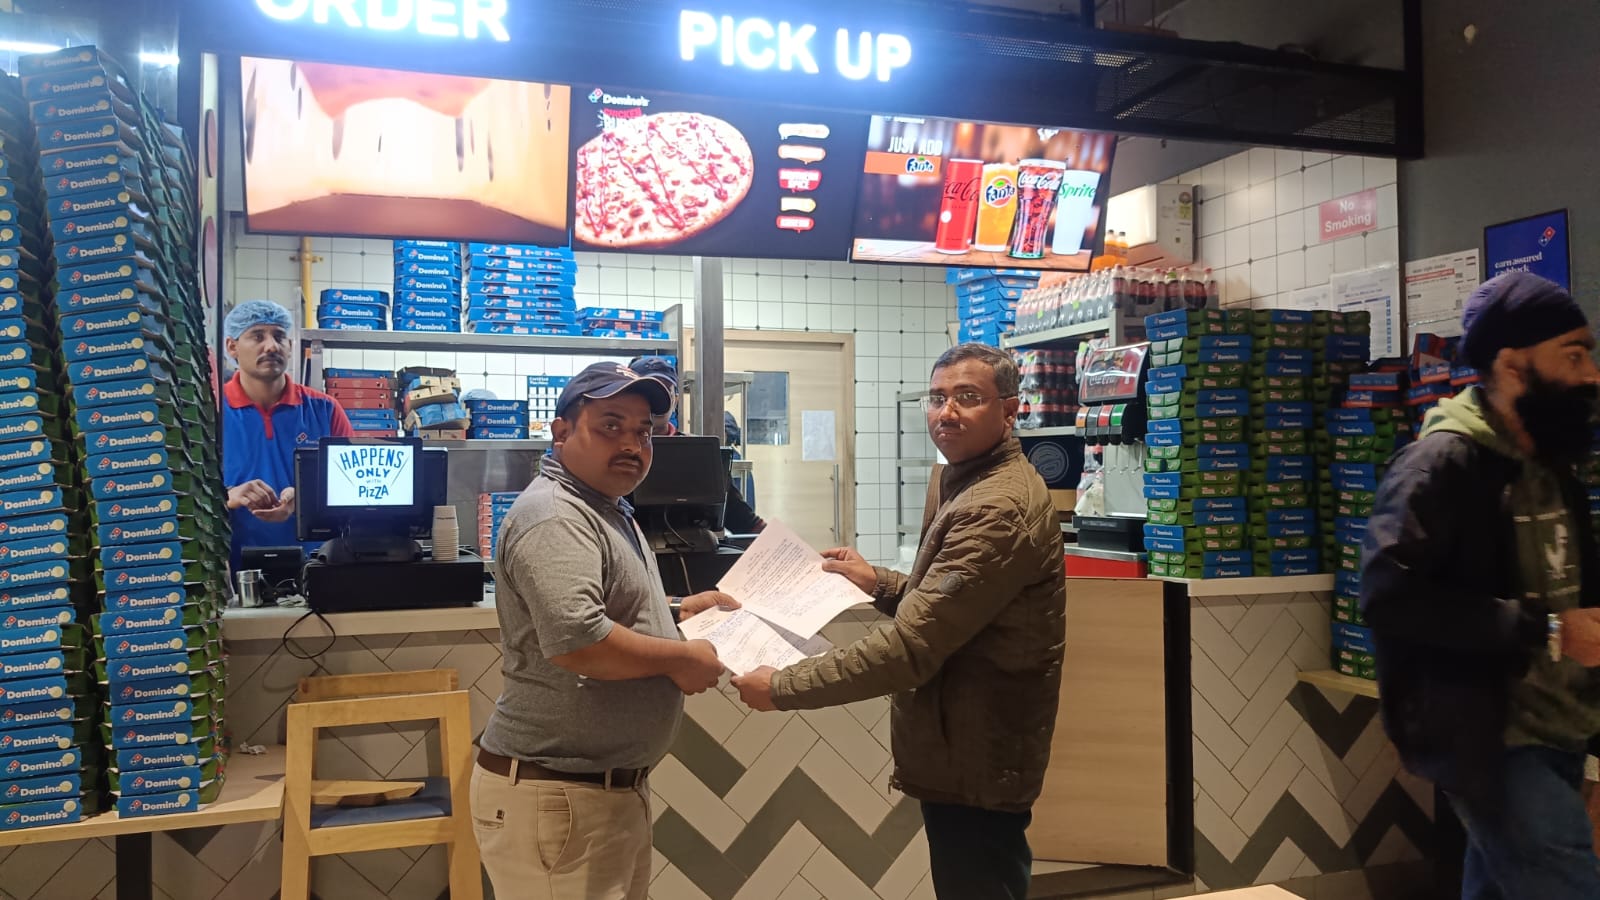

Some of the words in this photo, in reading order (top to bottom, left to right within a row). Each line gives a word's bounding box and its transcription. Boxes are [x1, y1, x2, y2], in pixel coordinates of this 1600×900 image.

[680, 10, 819, 73] PICK
[835, 28, 911, 81] UP
[918, 140, 943, 156] ADD
[906, 157, 934, 172] Fanta
[986, 184, 1016, 203] Fanta
[1060, 183, 1096, 198] Sprite
[72, 198, 116, 212] Domino's
[1339, 200, 1354, 214] No
[1325, 214, 1372, 233] Smoking
[86, 318, 130, 330] Domino's
[88, 342, 132, 354] Domino's
[94, 364, 138, 376] Domino's
[99, 388, 144, 400] Domino's
[340, 448, 404, 470] HAPPENS
[356, 468, 390, 478] ONLY
[12, 592, 56, 605] Domino's
[132, 664, 176, 676] Domino's
[136, 710, 180, 721] Domino's
[13, 734, 60, 748] Domino's
[20, 810, 68, 824] Domino's
